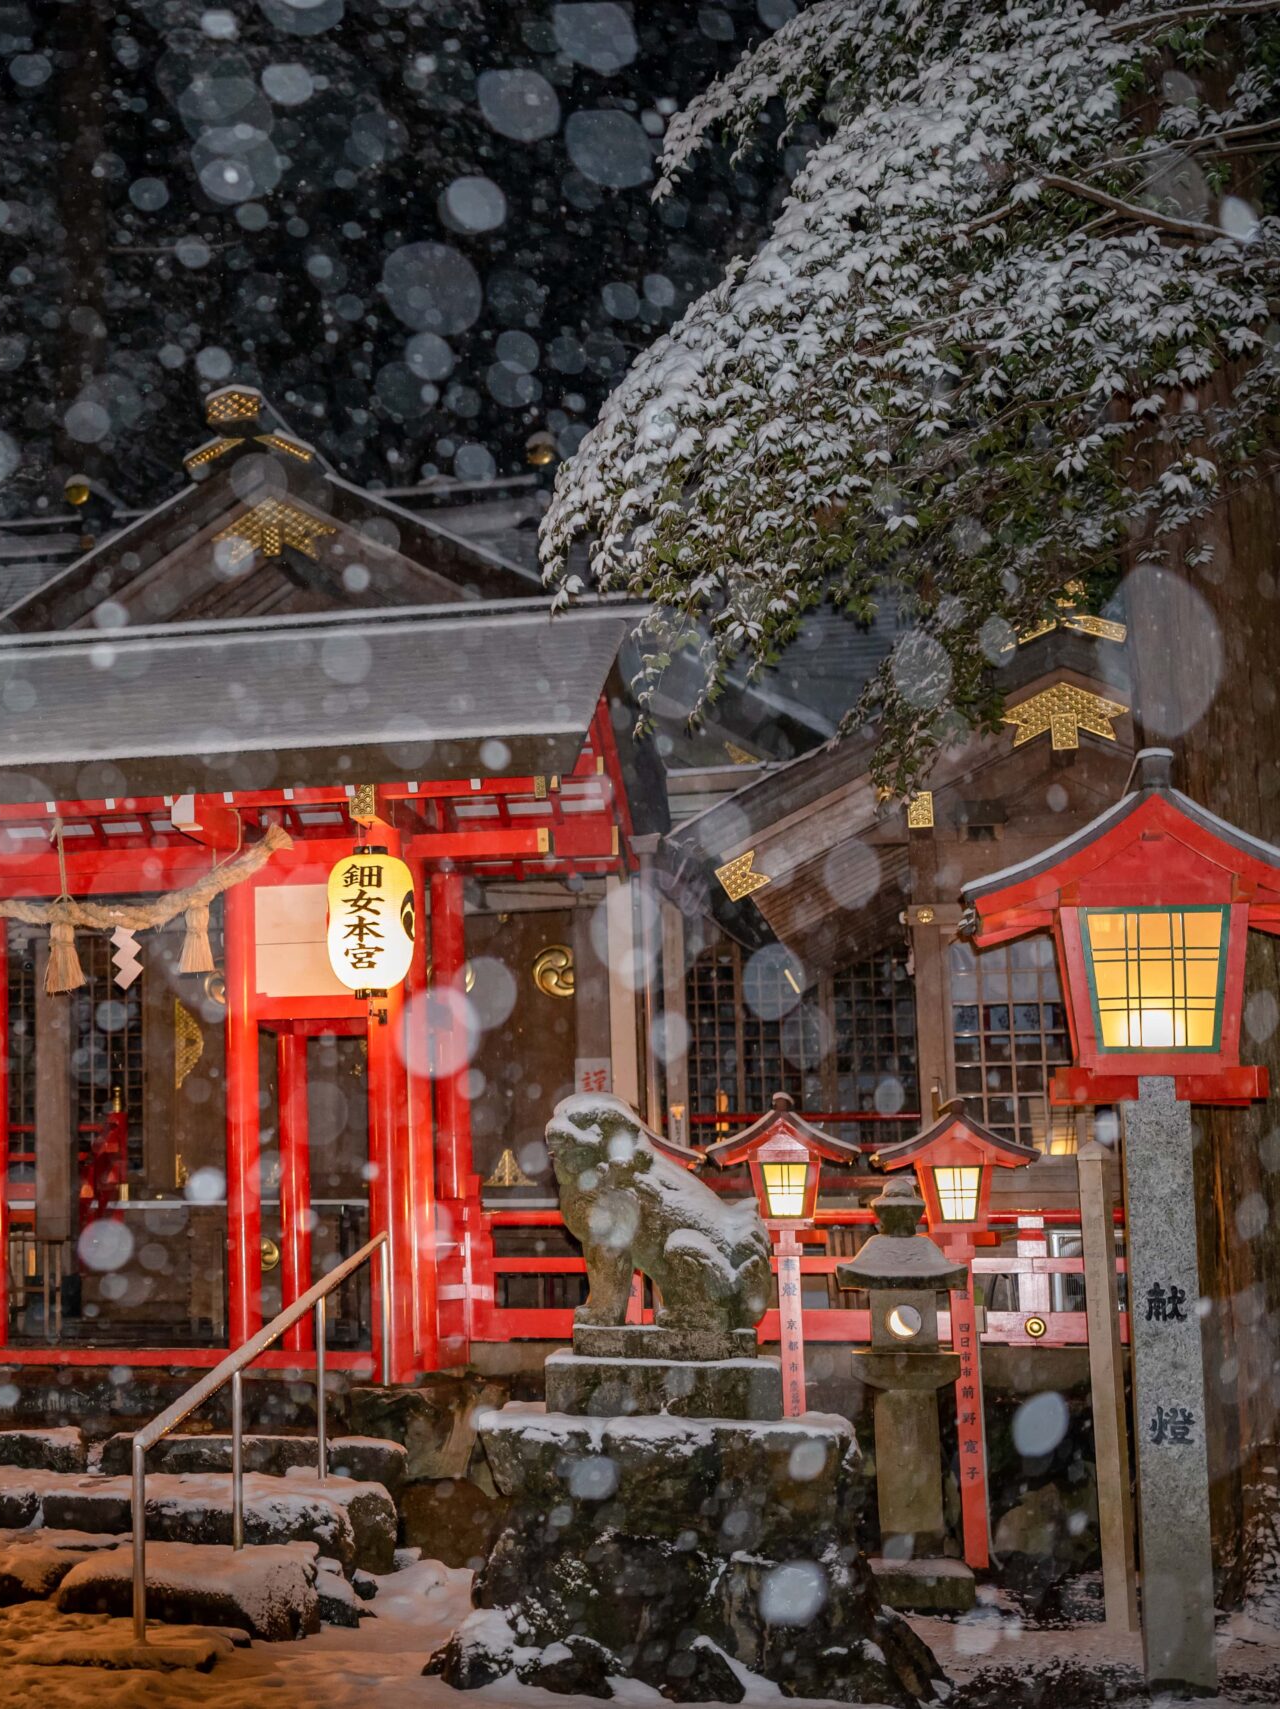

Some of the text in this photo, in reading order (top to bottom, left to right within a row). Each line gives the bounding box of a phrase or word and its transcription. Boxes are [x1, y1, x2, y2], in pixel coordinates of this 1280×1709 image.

[341, 863, 385, 970] 鈿女本宮
[786, 1318, 800, 1373] 京都市
